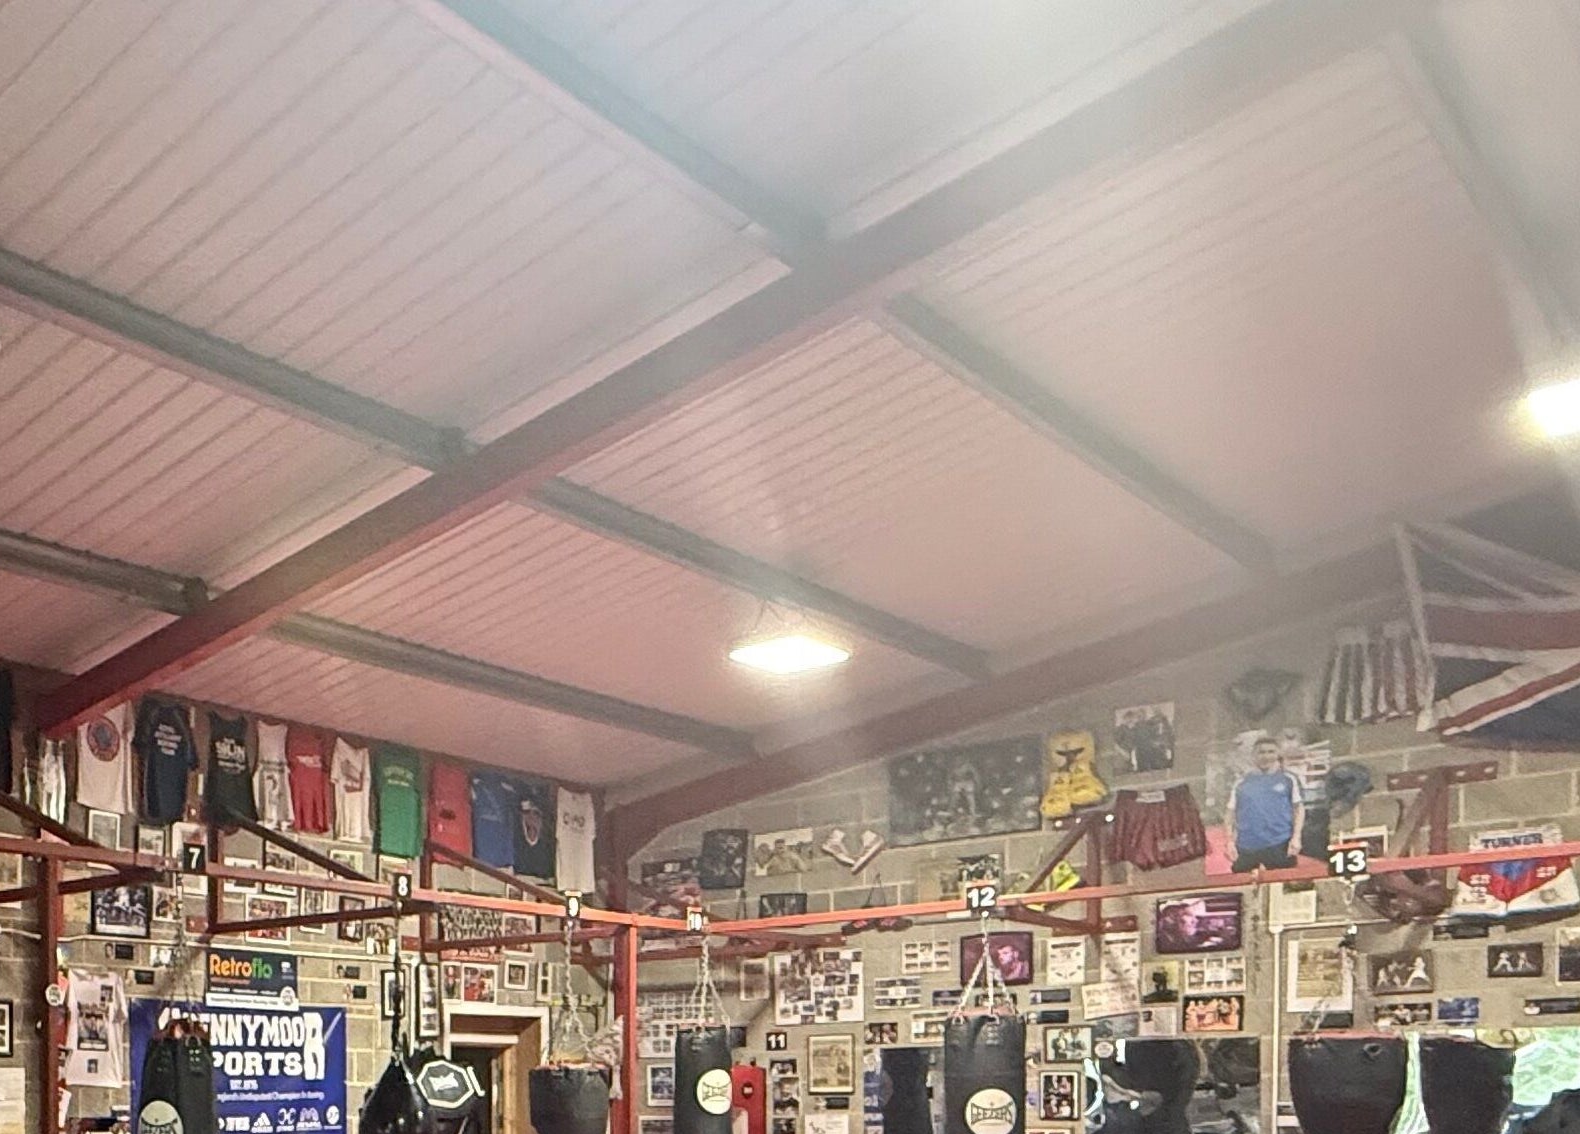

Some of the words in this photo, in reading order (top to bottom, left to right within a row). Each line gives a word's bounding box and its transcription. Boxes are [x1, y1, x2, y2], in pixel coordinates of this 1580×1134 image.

[188, 847, 201, 870] 7
[1330, 850, 1366, 873] 13
[397, 875, 409, 896] 8
[968, 886, 995, 908] 12
[768, 1034, 785, 1048] 11
[212, 1051, 302, 1077] PORTS
[970, 1100, 1013, 1126] GEEZERS
